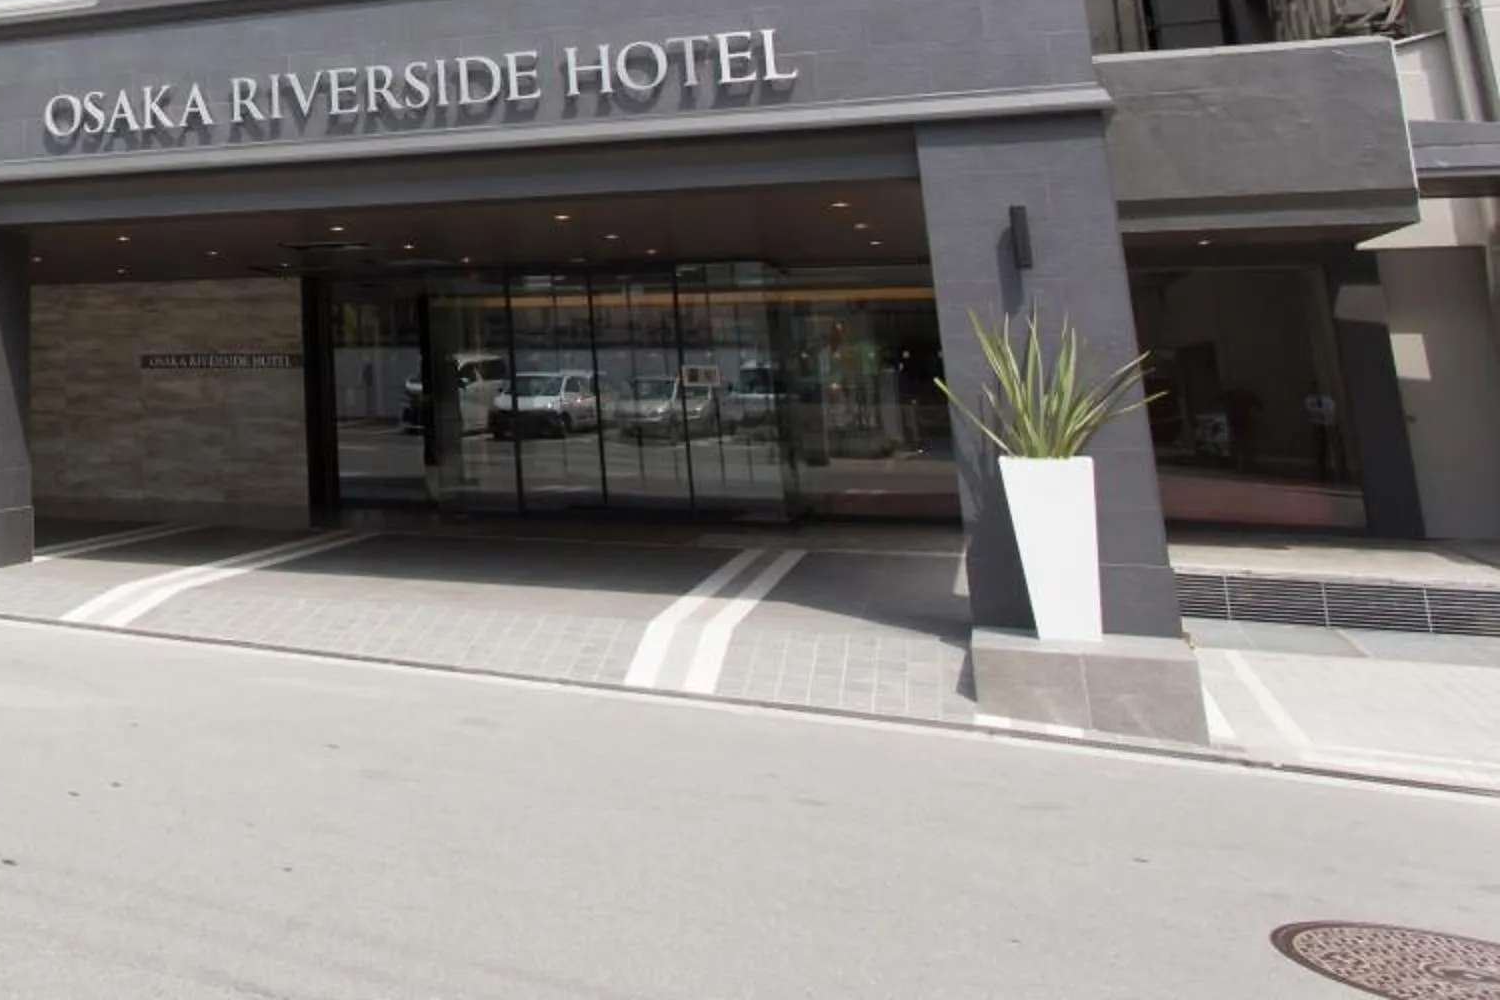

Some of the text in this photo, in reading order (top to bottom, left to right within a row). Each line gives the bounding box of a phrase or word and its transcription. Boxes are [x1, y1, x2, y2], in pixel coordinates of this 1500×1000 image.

[44, 29, 798, 138] OSAKA RIVERSIDE HOTEL
